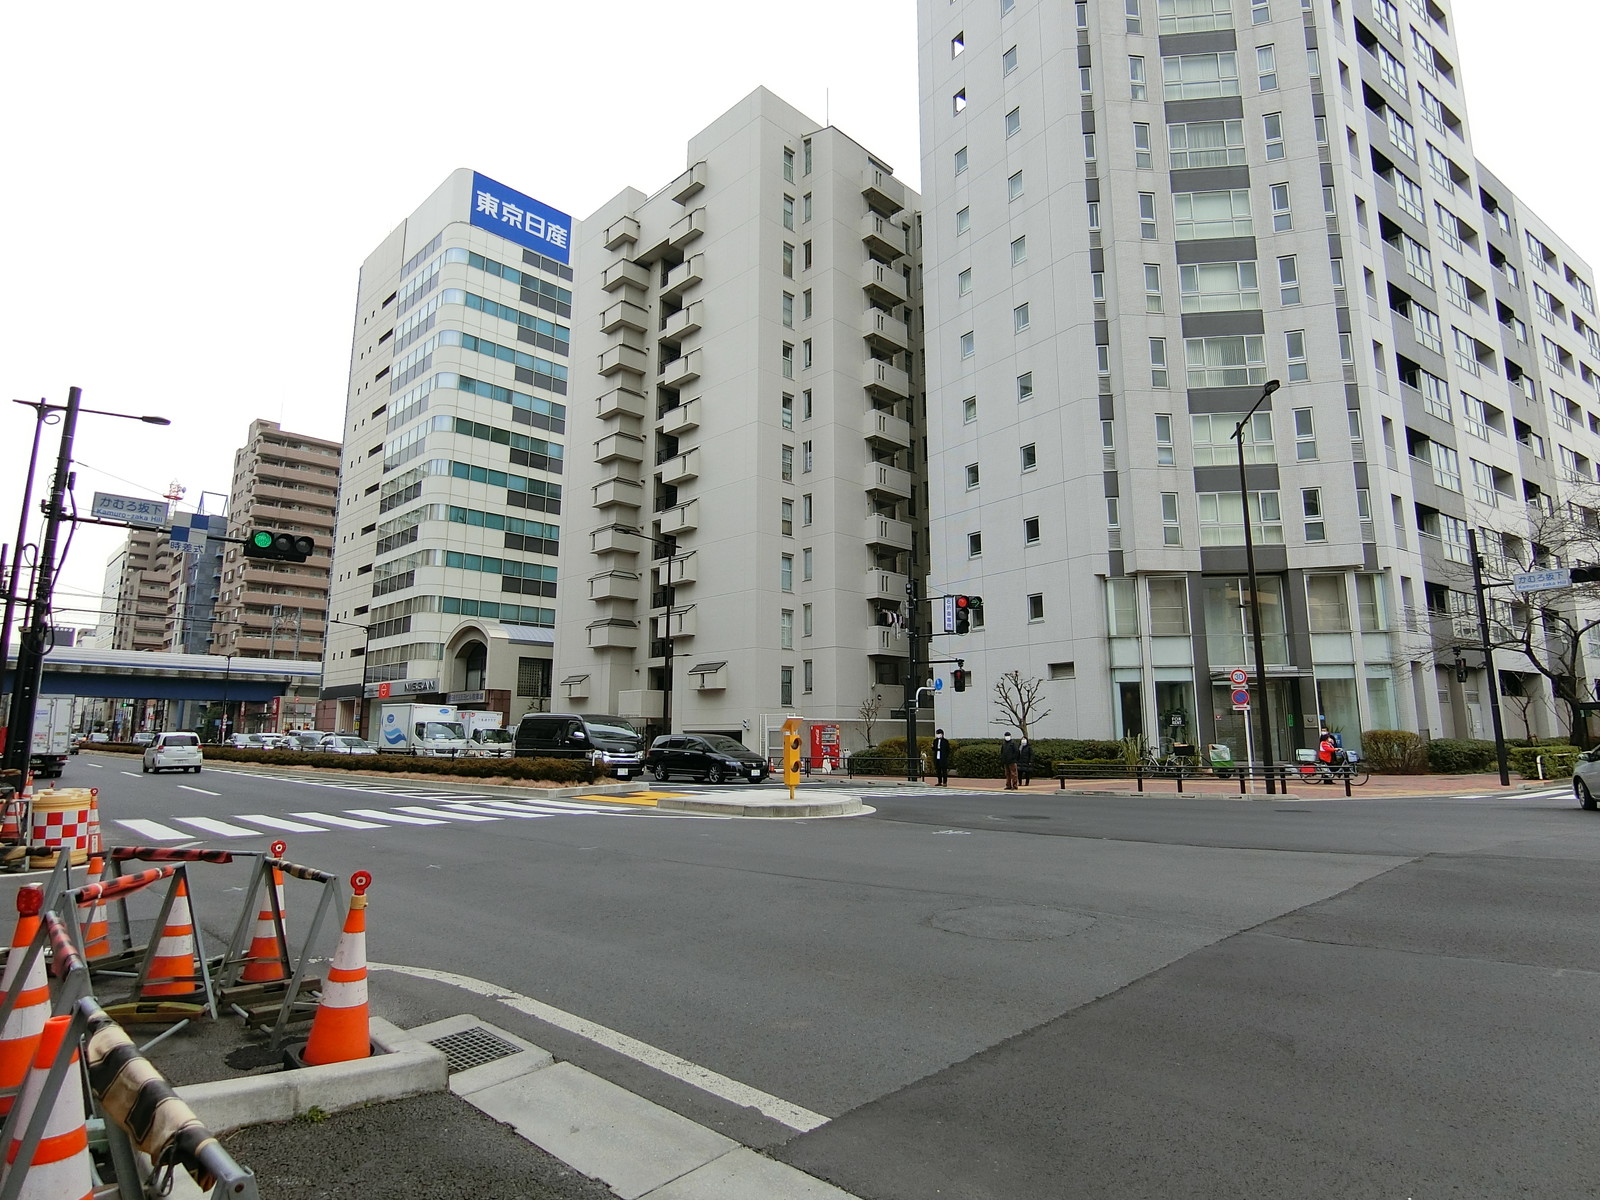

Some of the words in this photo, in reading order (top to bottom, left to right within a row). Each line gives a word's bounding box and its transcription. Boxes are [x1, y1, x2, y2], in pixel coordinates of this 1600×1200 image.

[476, 190, 567, 249] 東京日産
[100, 497, 163, 515] かむろ坂下
[96, 508, 149, 521] Kamuro-zaka
[170, 541, 204, 554] 時差式
[1518, 571, 1564, 584] かむろ坂下
[1234, 673, 1244, 681] 30
[404, 680, 436, 693] NISSAN
